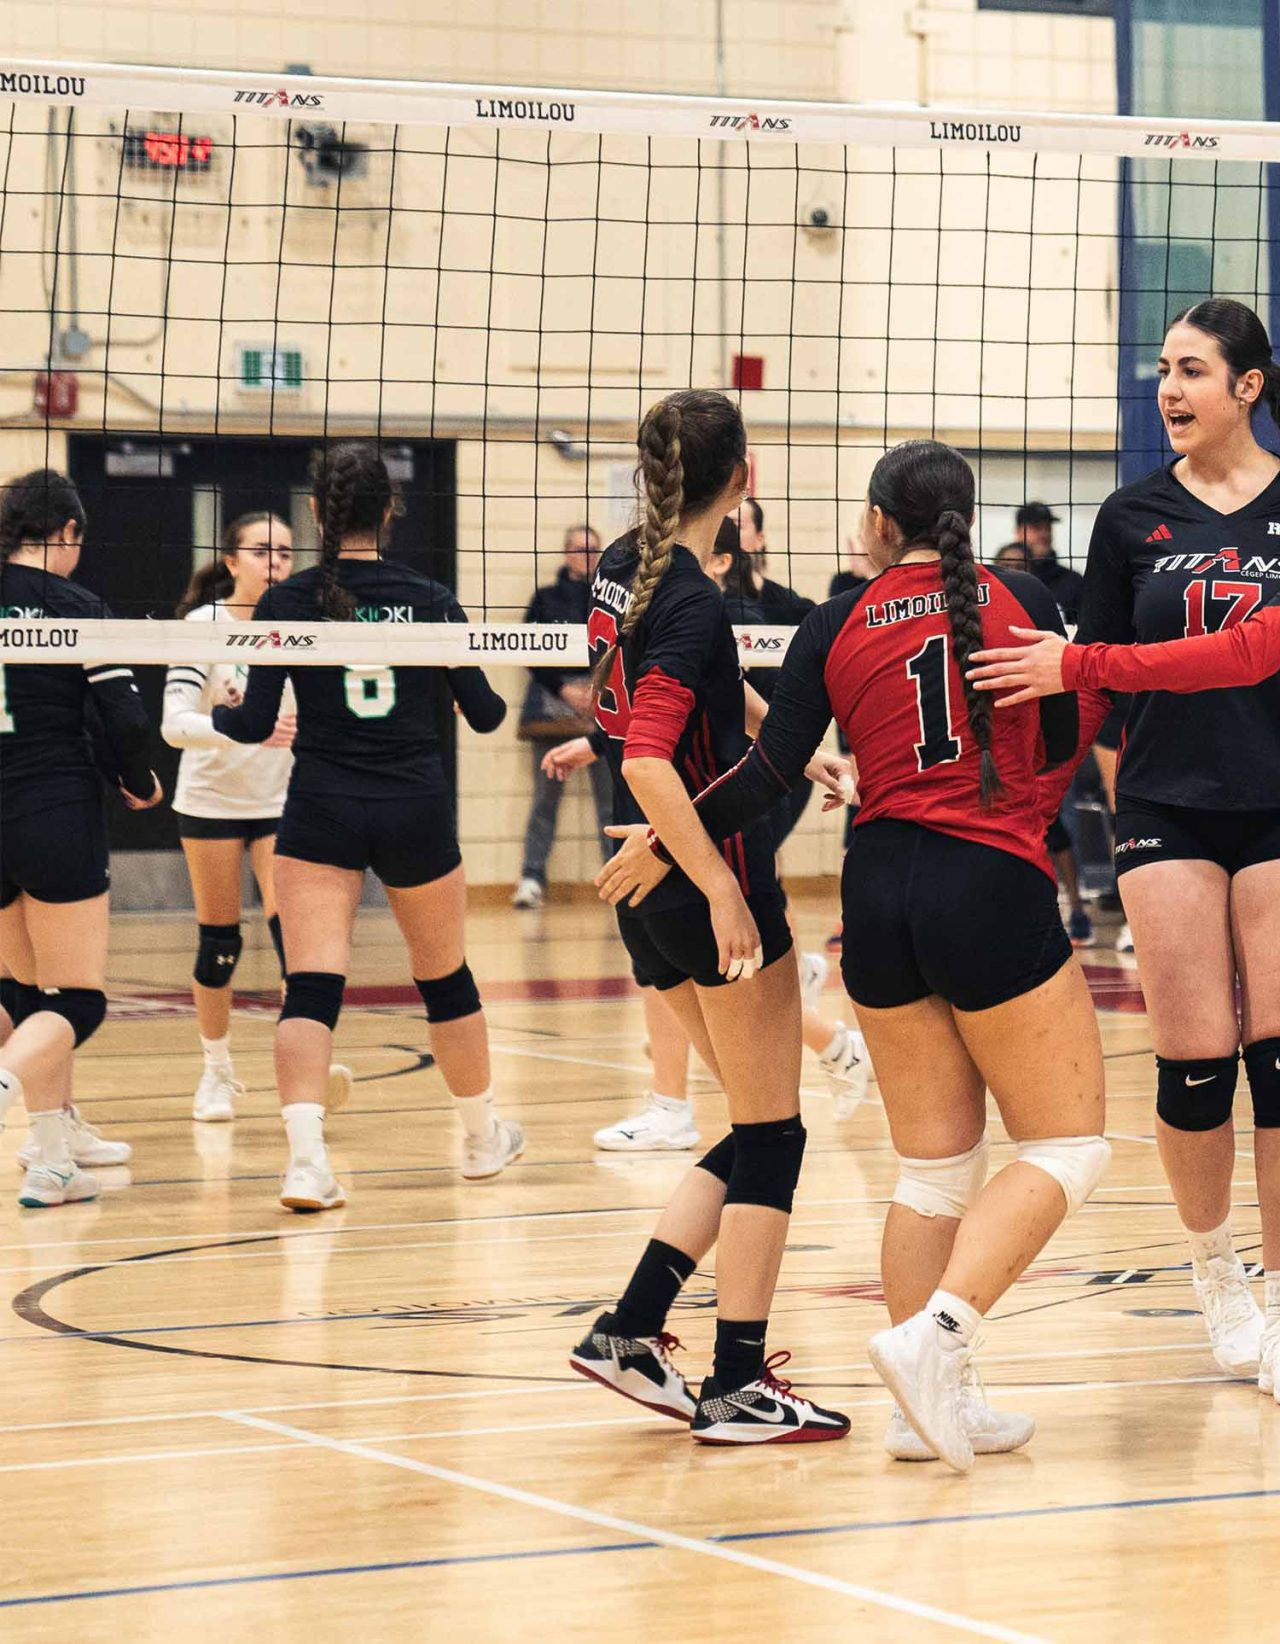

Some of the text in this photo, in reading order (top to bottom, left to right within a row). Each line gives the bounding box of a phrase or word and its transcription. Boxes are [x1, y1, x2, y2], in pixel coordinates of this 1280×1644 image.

[0, 73, 85, 96] MOILOU
[233, 88, 325, 108] TITANS
[476, 99, 575, 122] LIMOILOU
[709, 112, 792, 132] TITANS
[930, 121, 1021, 143] LIMOILOU
[1144, 129, 1220, 149] TITANS
[866, 583, 990, 628] LIMOILU
[1183, 579, 1262, 639] 17
[225, 630, 318, 650] TITANS
[468, 632, 568, 651] LIMOILOU
[906, 634, 961, 772] 1
